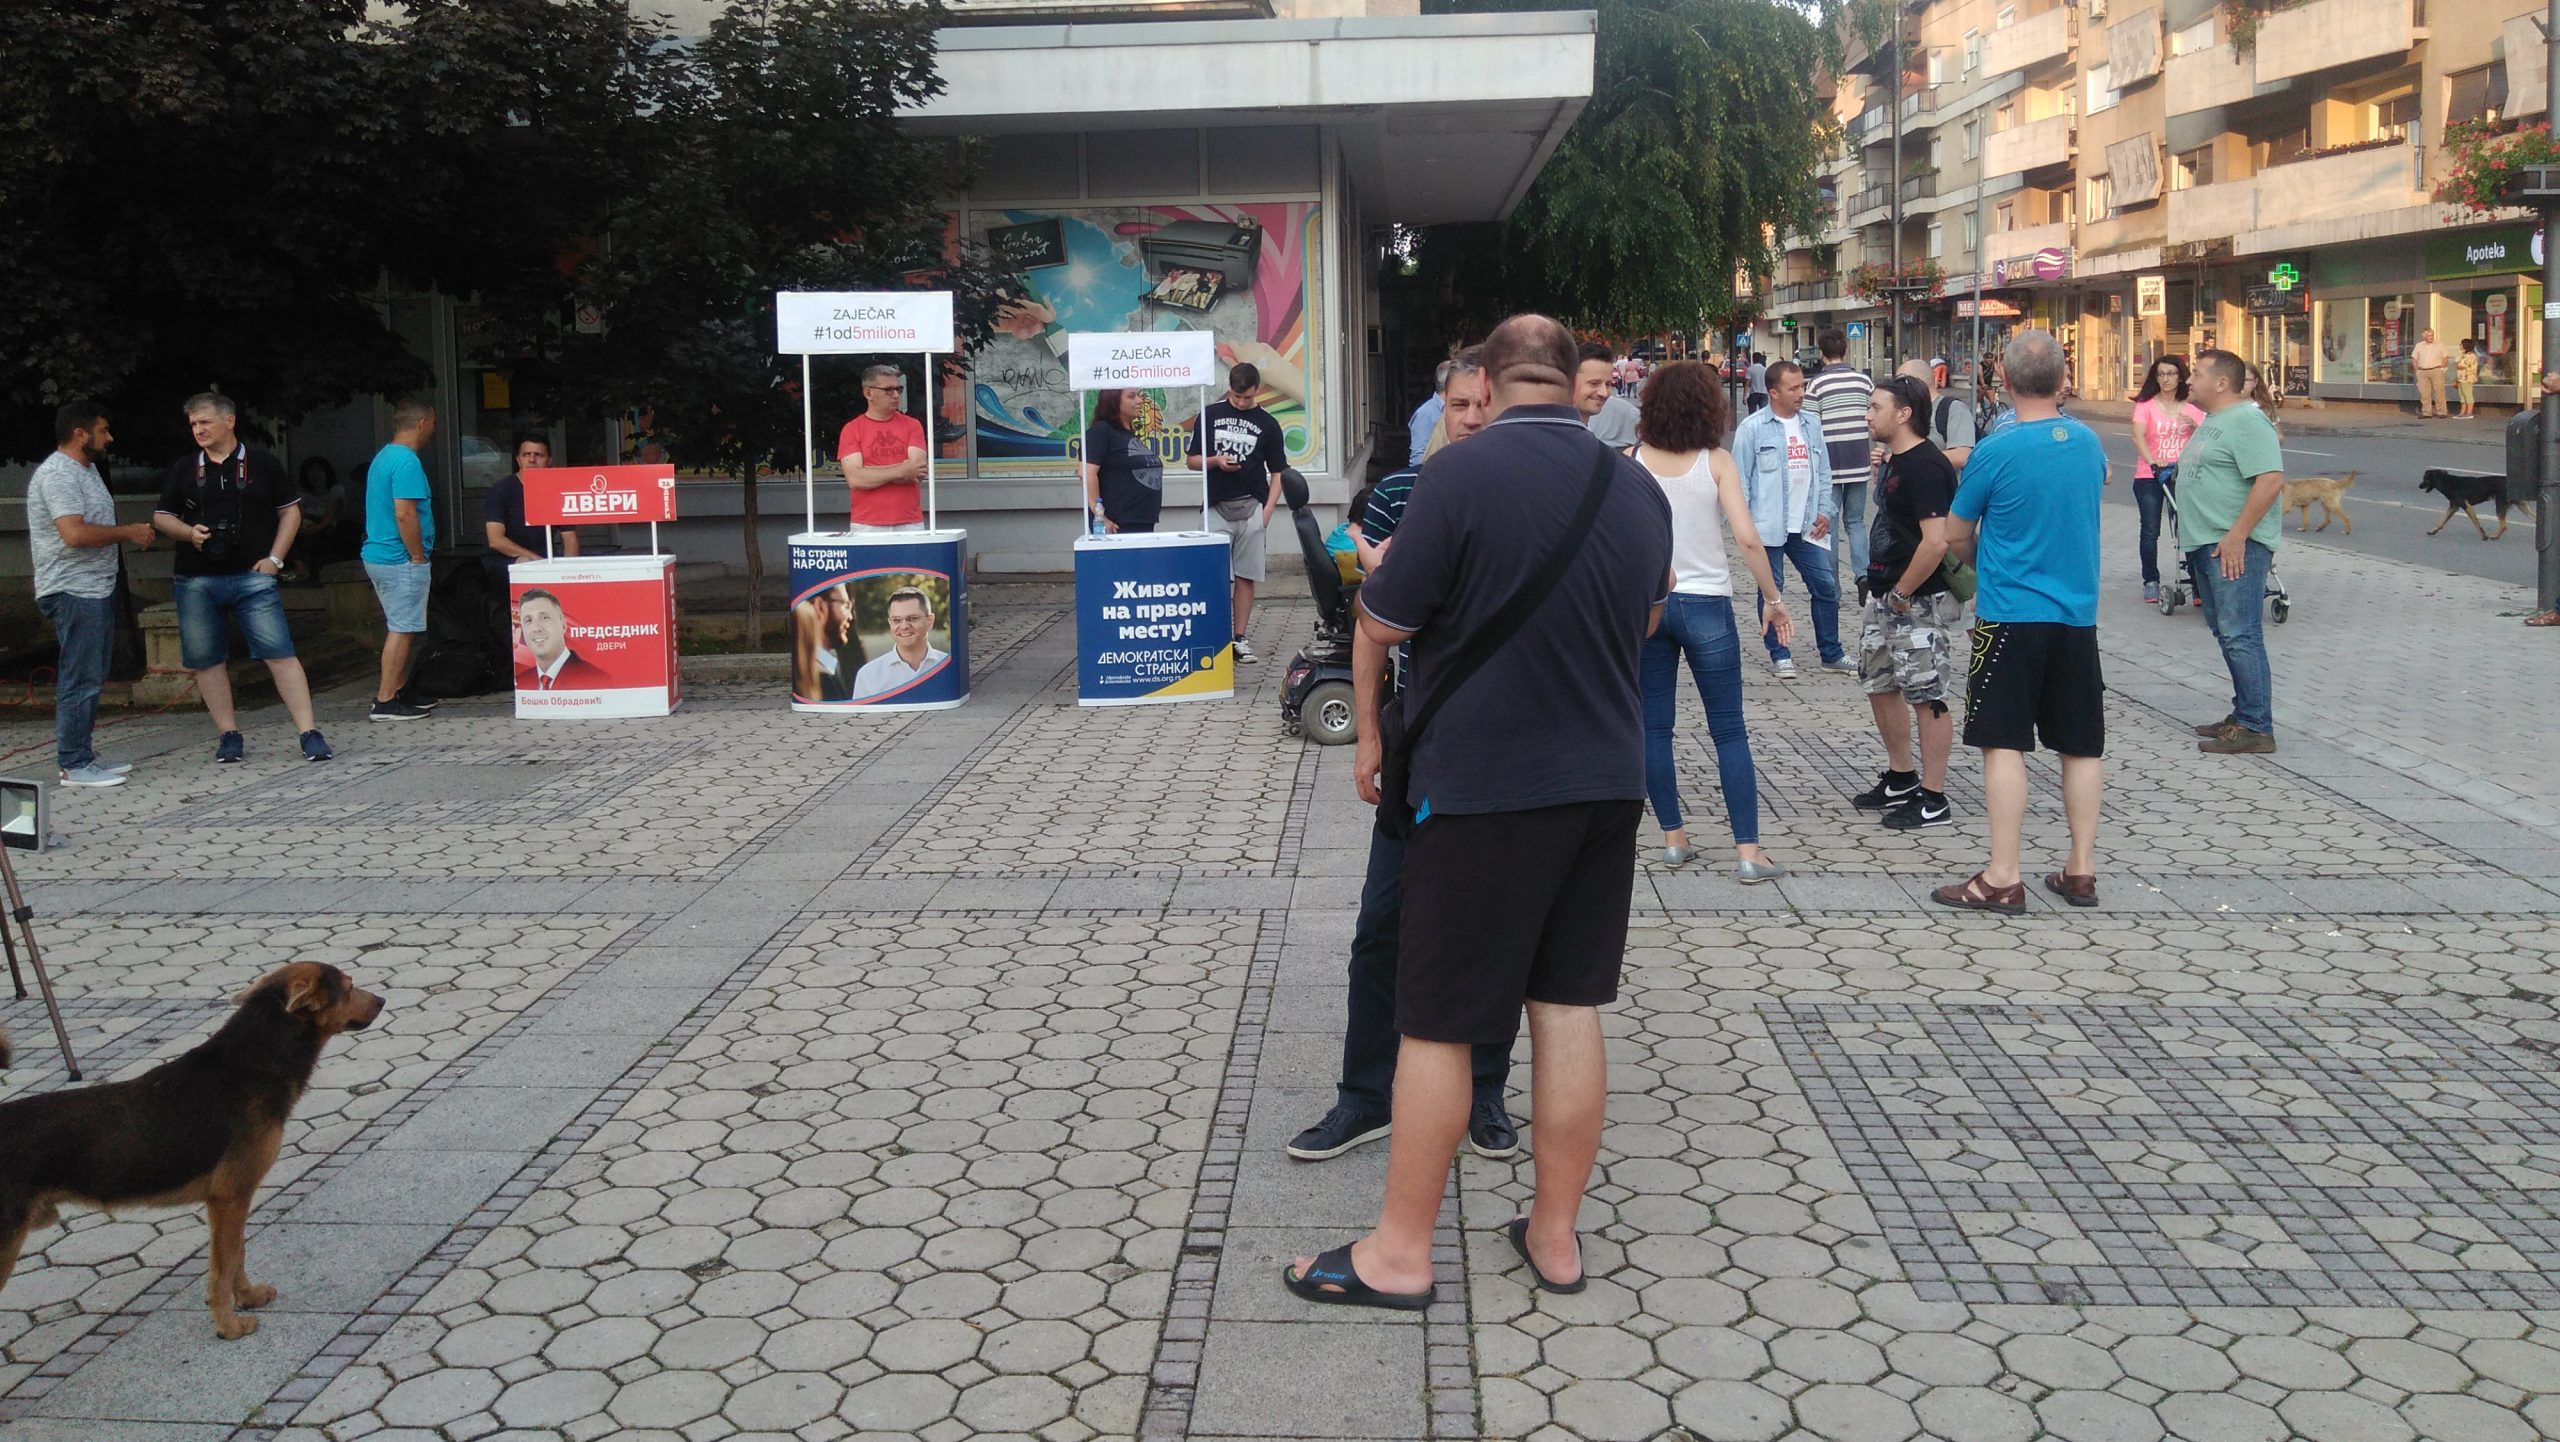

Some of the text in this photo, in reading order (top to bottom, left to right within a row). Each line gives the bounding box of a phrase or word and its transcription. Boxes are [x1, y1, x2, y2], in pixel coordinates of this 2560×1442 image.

[2466, 242, 2506, 264] Apoteka
[833, 307, 896, 320] ZAJEČAR
[814, 326, 916, 340] #1od5miliona
[1111, 346, 1171, 360] ZAJEČAR
[1093, 365, 1191, 380] #1od5miliona
[1227, 425, 1248, 434] КОЈА
[562, 493, 638, 513] ДВЕРИ
[793, 547, 848, 560] На страни
[793, 559, 848, 571] НАРОДА!
[1113, 581, 1191, 599] Живот
[1102, 602, 1207, 622] на првом
[570, 624, 659, 639] ПРЕДСЕДНИК
[1119, 619, 1192, 642] месту!
[596, 641, 627, 651] ДВЕРИ
[1097, 648, 1189, 665] ДЕМОКРАТСКА
[1135, 662, 1189, 676] СТРАНКА
[1132, 675, 1182, 684] www.ds.org.rs
[521, 697, 549, 706] Бошко
